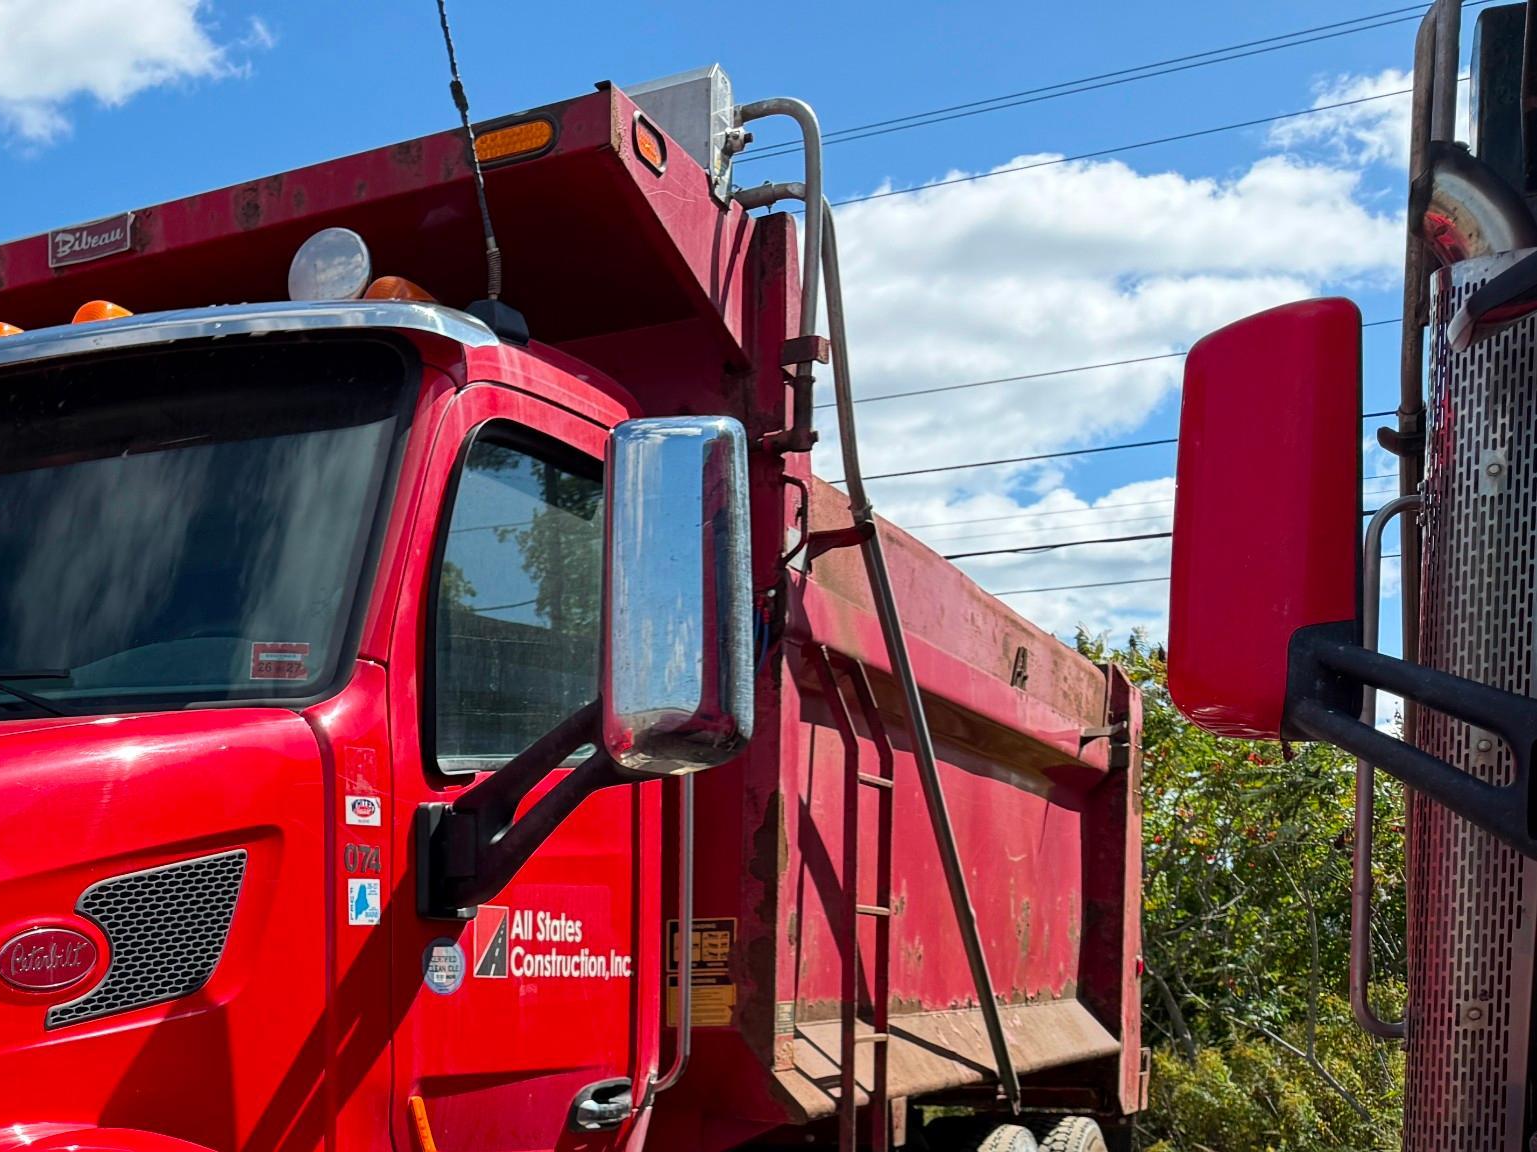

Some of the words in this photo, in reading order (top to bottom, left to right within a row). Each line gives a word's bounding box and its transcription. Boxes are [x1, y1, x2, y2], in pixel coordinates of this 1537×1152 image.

[54, 226, 124, 258] Bibeau
[344, 843, 382, 875] 074
[511, 910, 533, 941] All
[537, 911, 583, 943] States
[10, 939, 89, 977] Peterbilt
